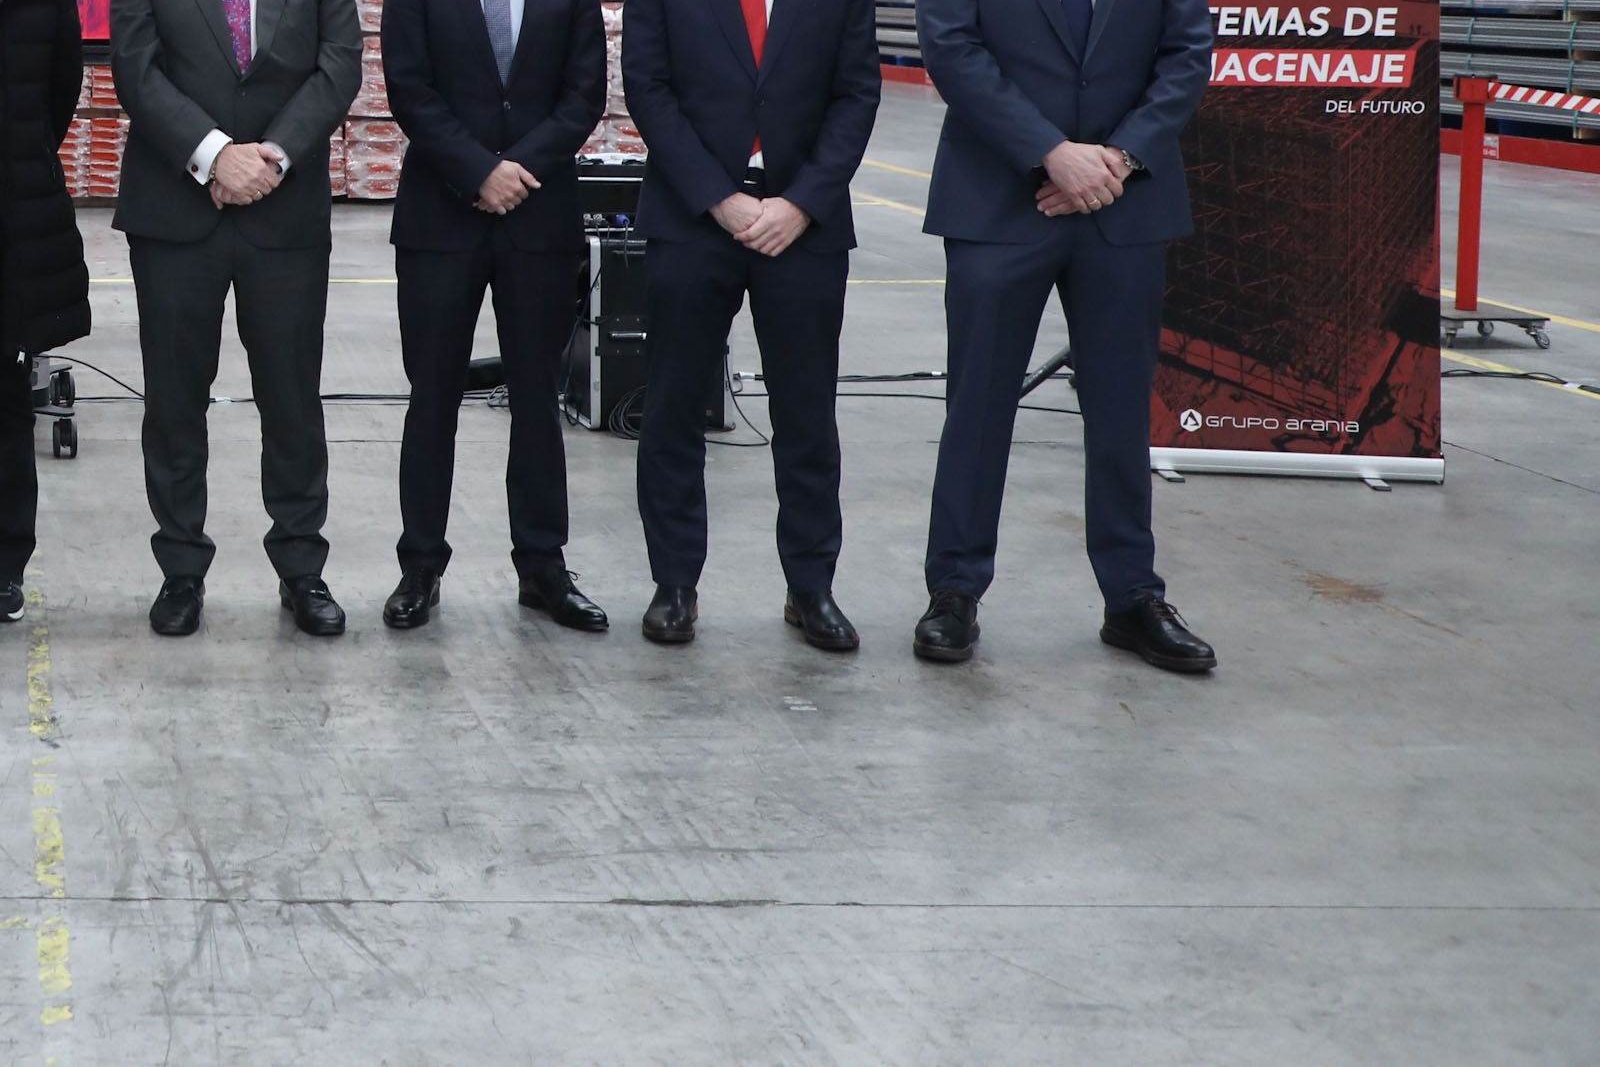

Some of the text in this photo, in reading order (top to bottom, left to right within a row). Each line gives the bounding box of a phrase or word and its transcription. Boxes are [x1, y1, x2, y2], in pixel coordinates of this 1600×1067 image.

[1343, 7, 1398, 37] DE
[1325, 100, 1425, 114] DEL FUTURO
[1285, 417, 1359, 432] arania
